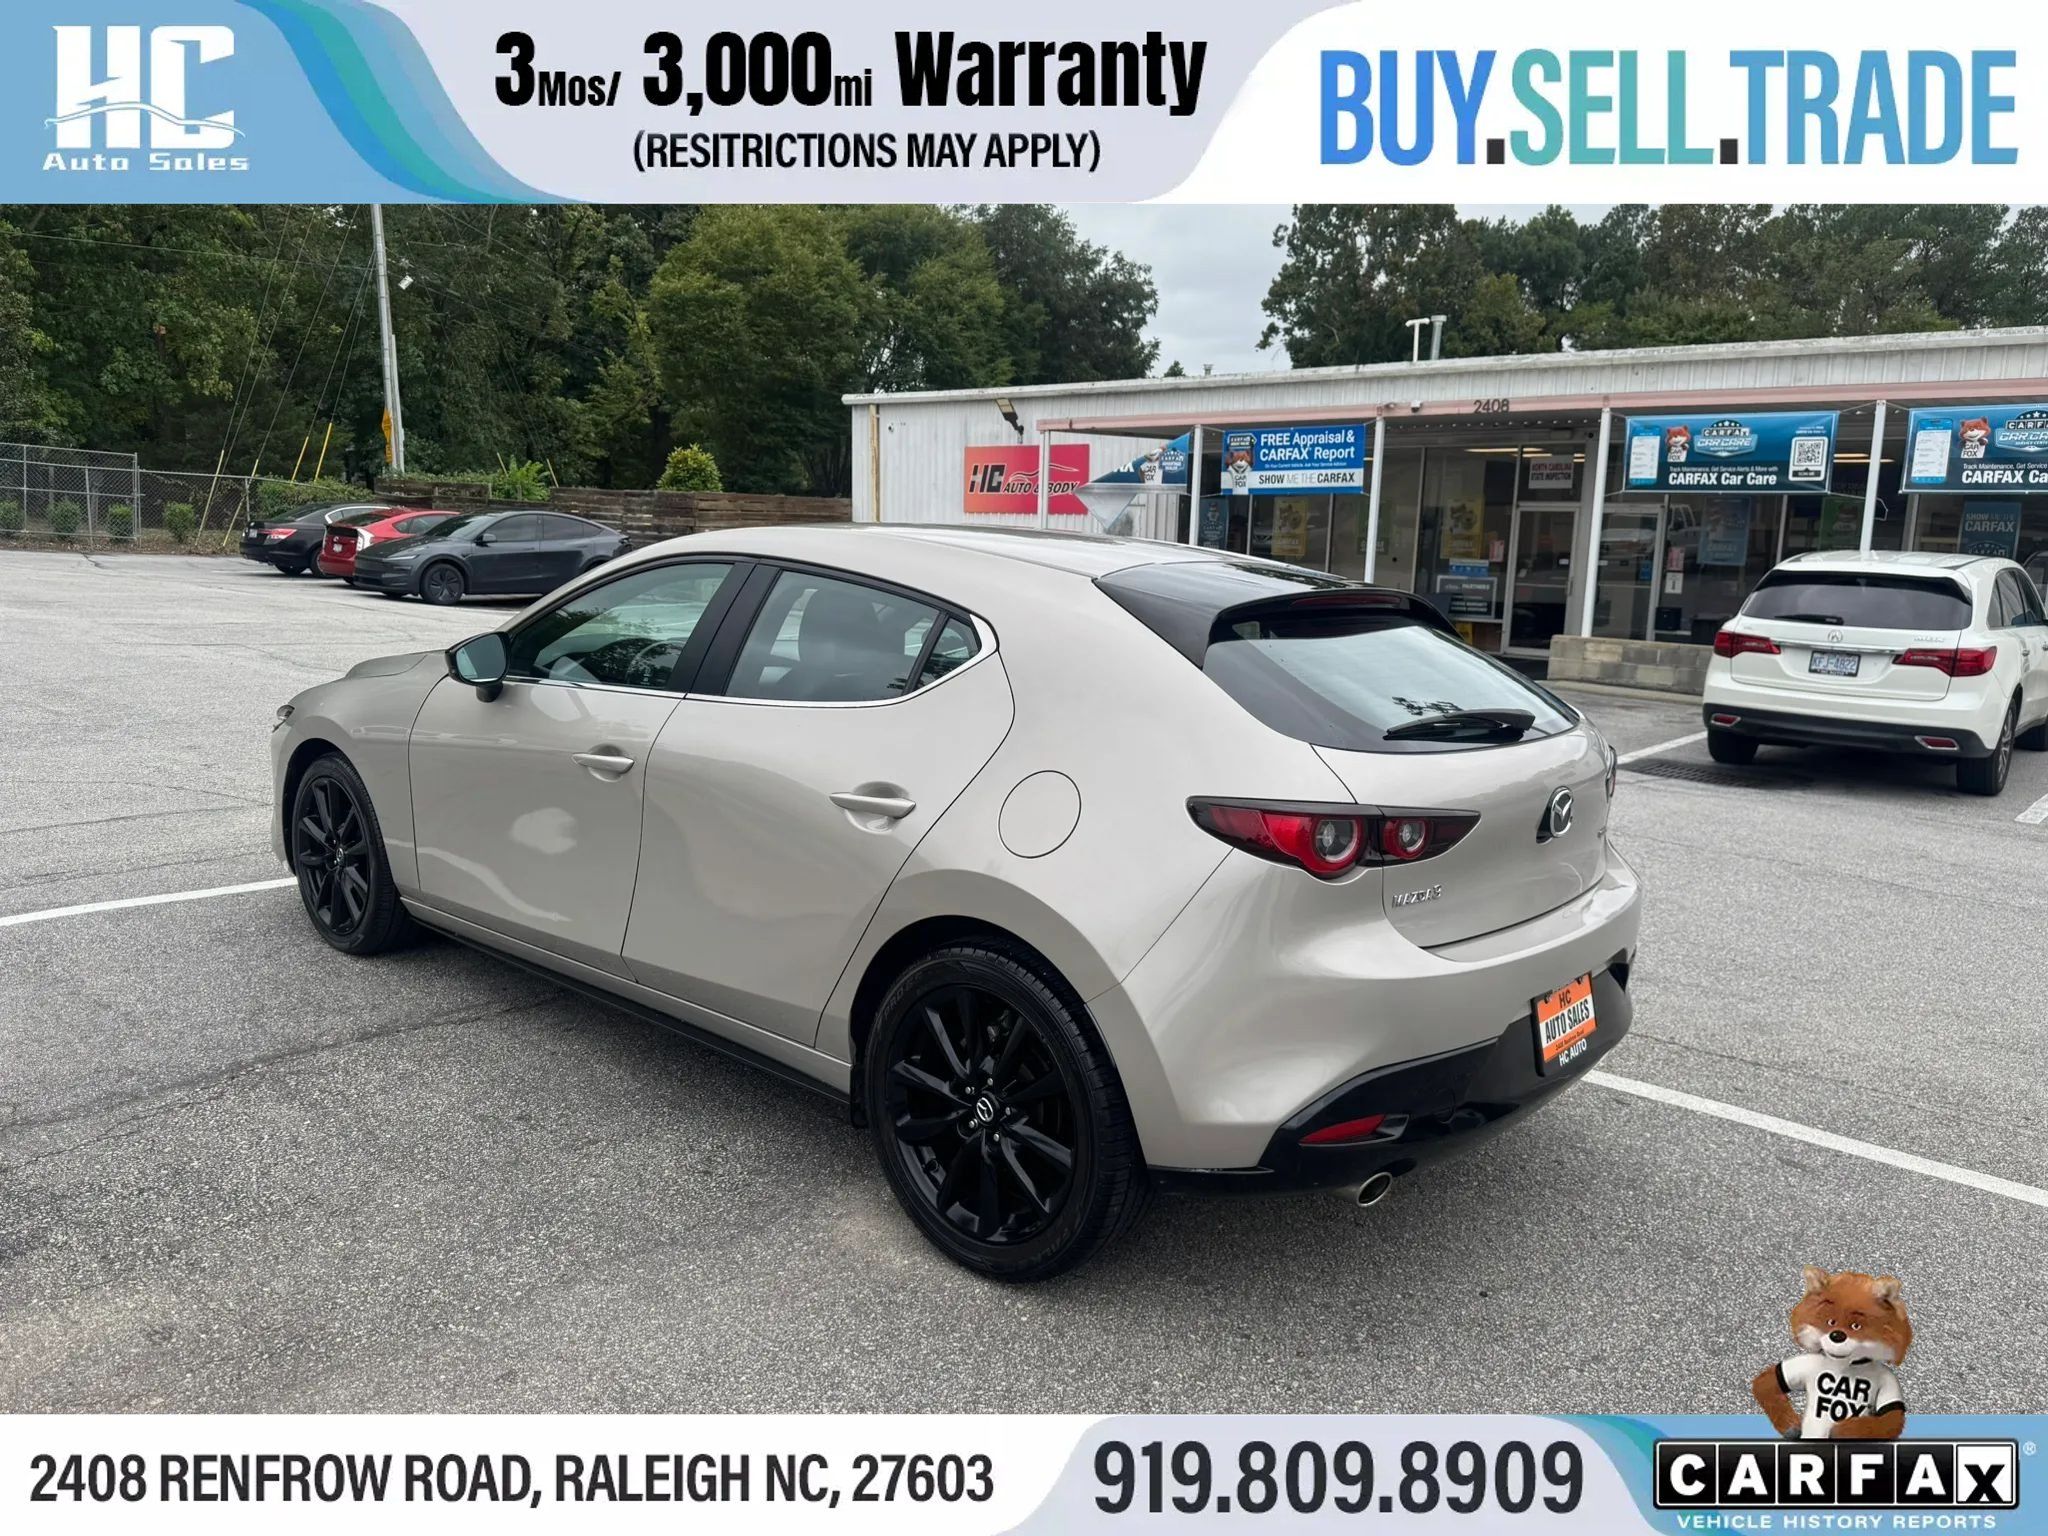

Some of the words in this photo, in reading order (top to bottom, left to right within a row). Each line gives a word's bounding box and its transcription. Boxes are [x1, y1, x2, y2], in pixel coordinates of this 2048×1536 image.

[1473, 399, 1510, 414] 2408
[1261, 433, 1291, 446] FREE
[1292, 430, 1345, 446] Appraisal
[1346, 430, 1355, 443] &
[1260, 448, 1309, 461] CARFAX
[1314, 446, 1355, 461] Report
[969, 464, 1006, 493] HC
[1003, 482, 1032, 493] AUTO
[1258, 473, 1285, 485] SHOW
[1287, 474, 1299, 484] ME
[1301, 473, 1317, 483] THE
[1317, 472, 1355, 483] CARFAX
[1668, 472, 1718, 485] CARFAX
[1720, 472, 1744, 485] Car
[1746, 472, 1777, 485] Care
[1961, 470, 2025, 484] CARFAX
[1964, 520, 2016, 532] CARFAX
[1558, 990, 1572, 1009] HC
[1545, 1012, 1567, 1044] AUTO
[1567, 998, 1590, 1030] SALES
[1558, 1049, 1570, 1067] HC
[1570, 1038, 1588, 1060] AUTO
